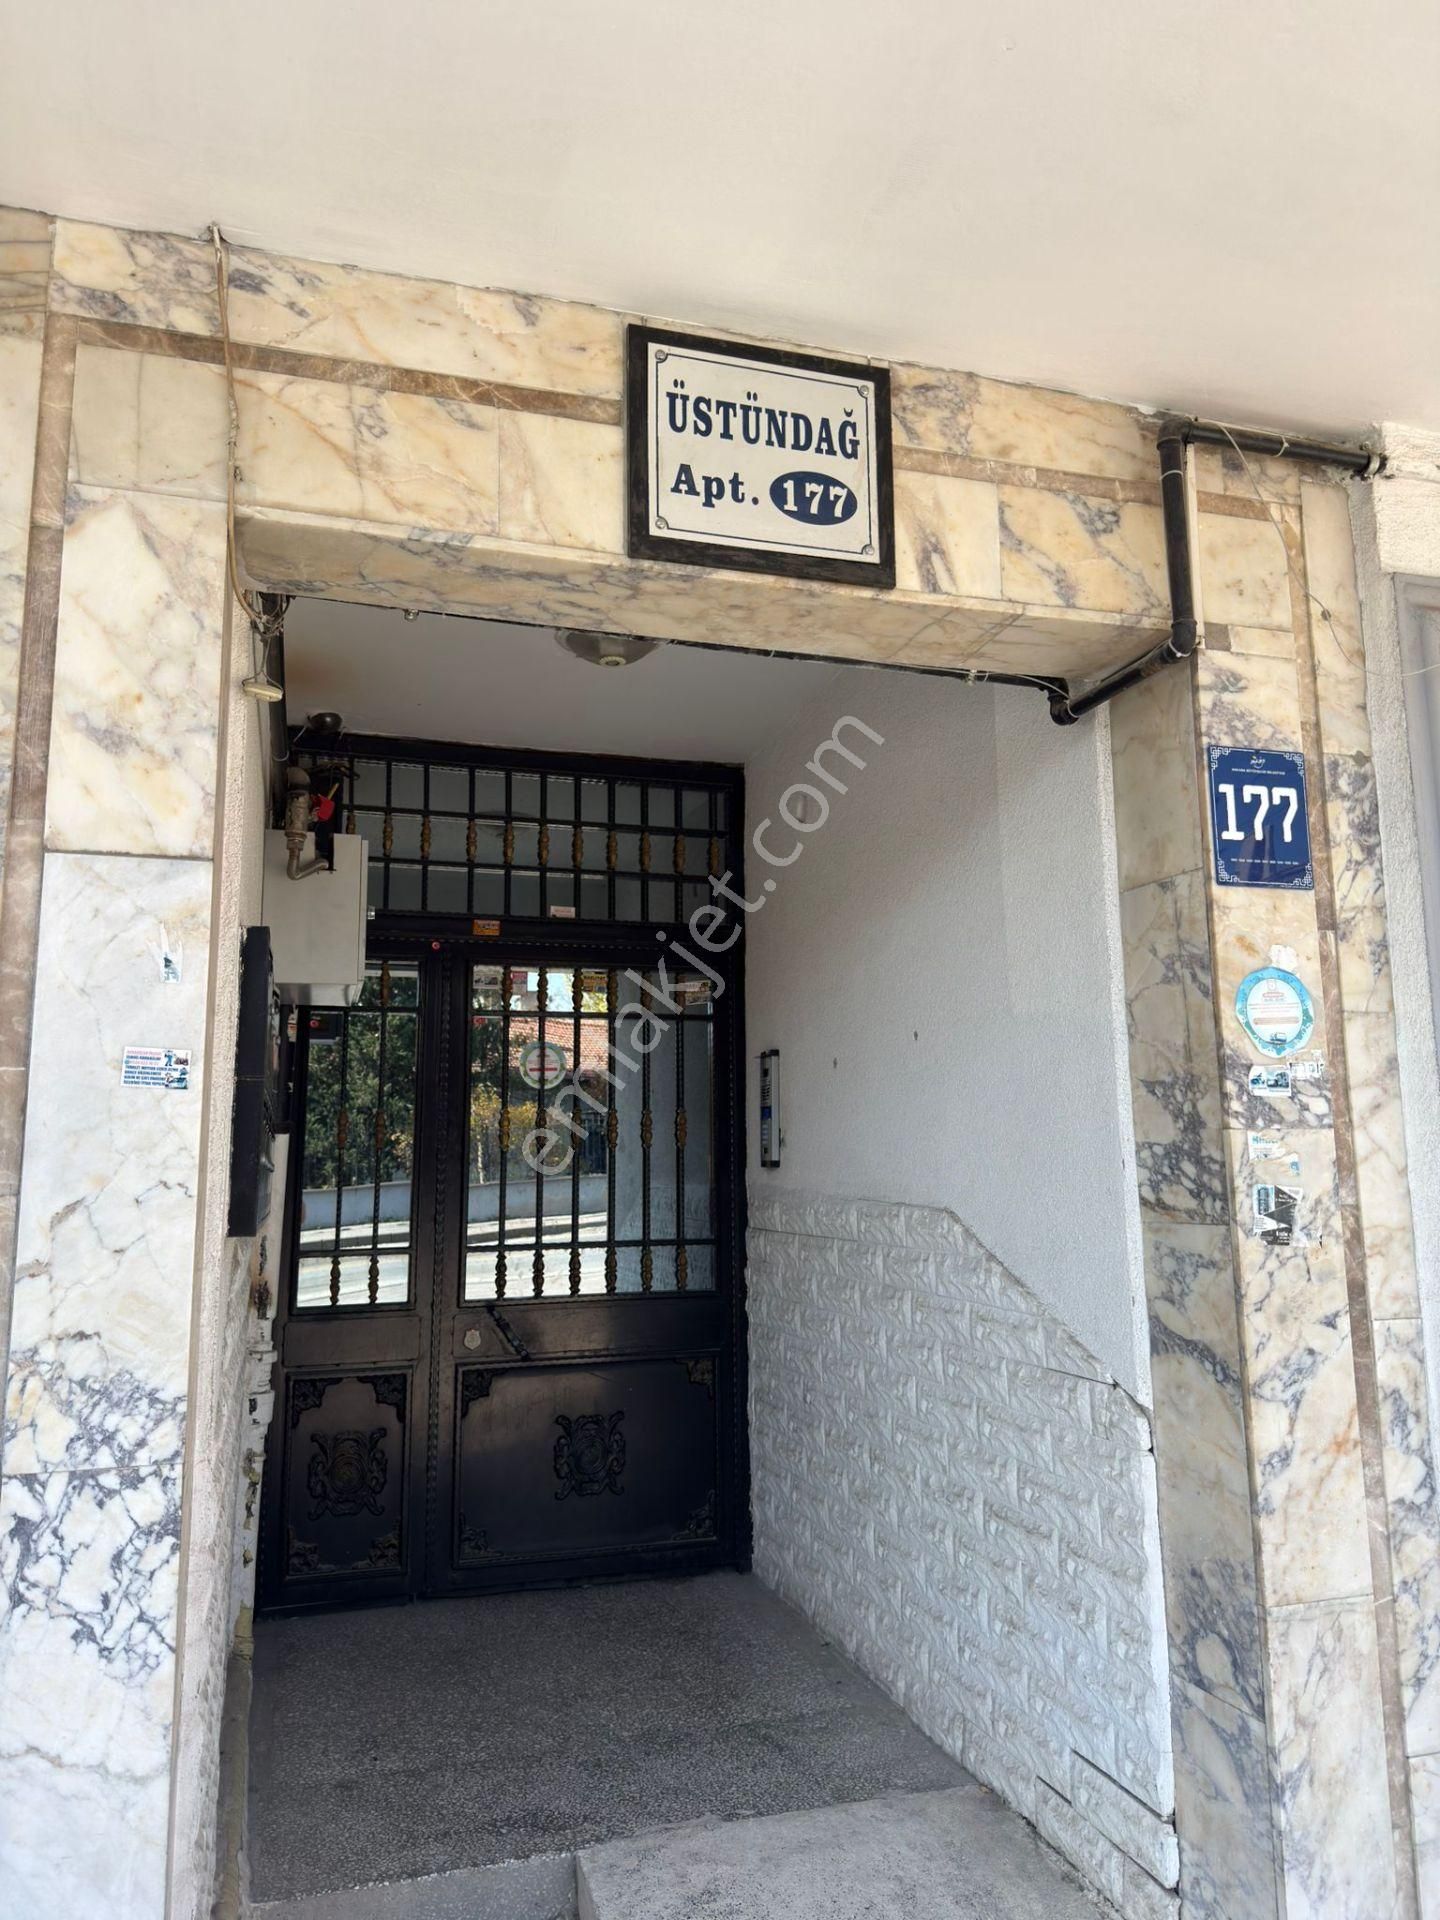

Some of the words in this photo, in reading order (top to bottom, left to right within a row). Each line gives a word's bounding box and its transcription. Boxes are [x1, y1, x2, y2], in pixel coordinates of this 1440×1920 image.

[666, 378, 860, 460] ÜSTÜNDAĞ
[670, 463, 759, 508] Apt.
[783, 479, 848, 518] 177
[1218, 783, 1298, 843] 177
